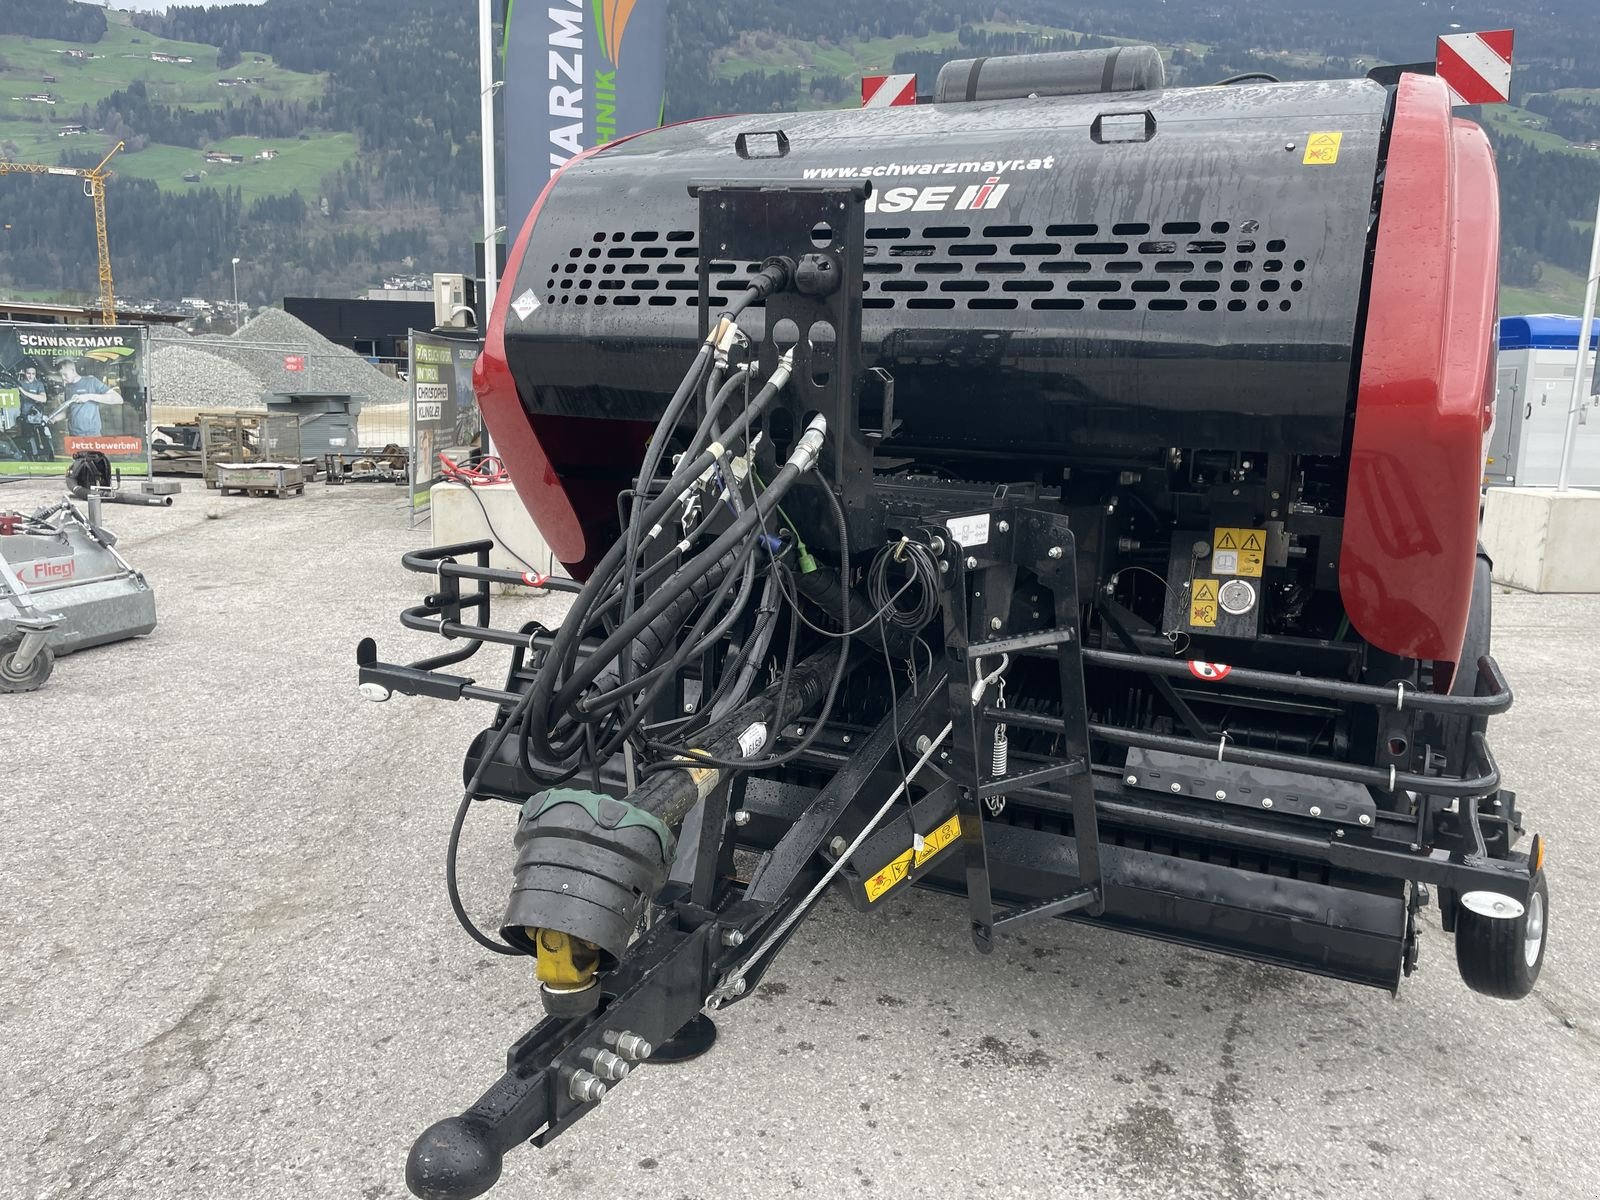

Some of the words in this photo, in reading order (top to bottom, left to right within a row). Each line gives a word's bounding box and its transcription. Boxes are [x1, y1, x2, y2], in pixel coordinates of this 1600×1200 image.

[548, 0, 584, 180] ARZM
[802, 155, 1055, 179] www.schwarzmayr.at
[20, 334, 124, 347] SCHWARZMAYR
[23, 347, 84, 356] LANDTECHNIK
[71, 441, 93, 449] Jetzt
[95, 441, 139, 450] bewerben!
[34, 559, 75, 577] Fliegl
